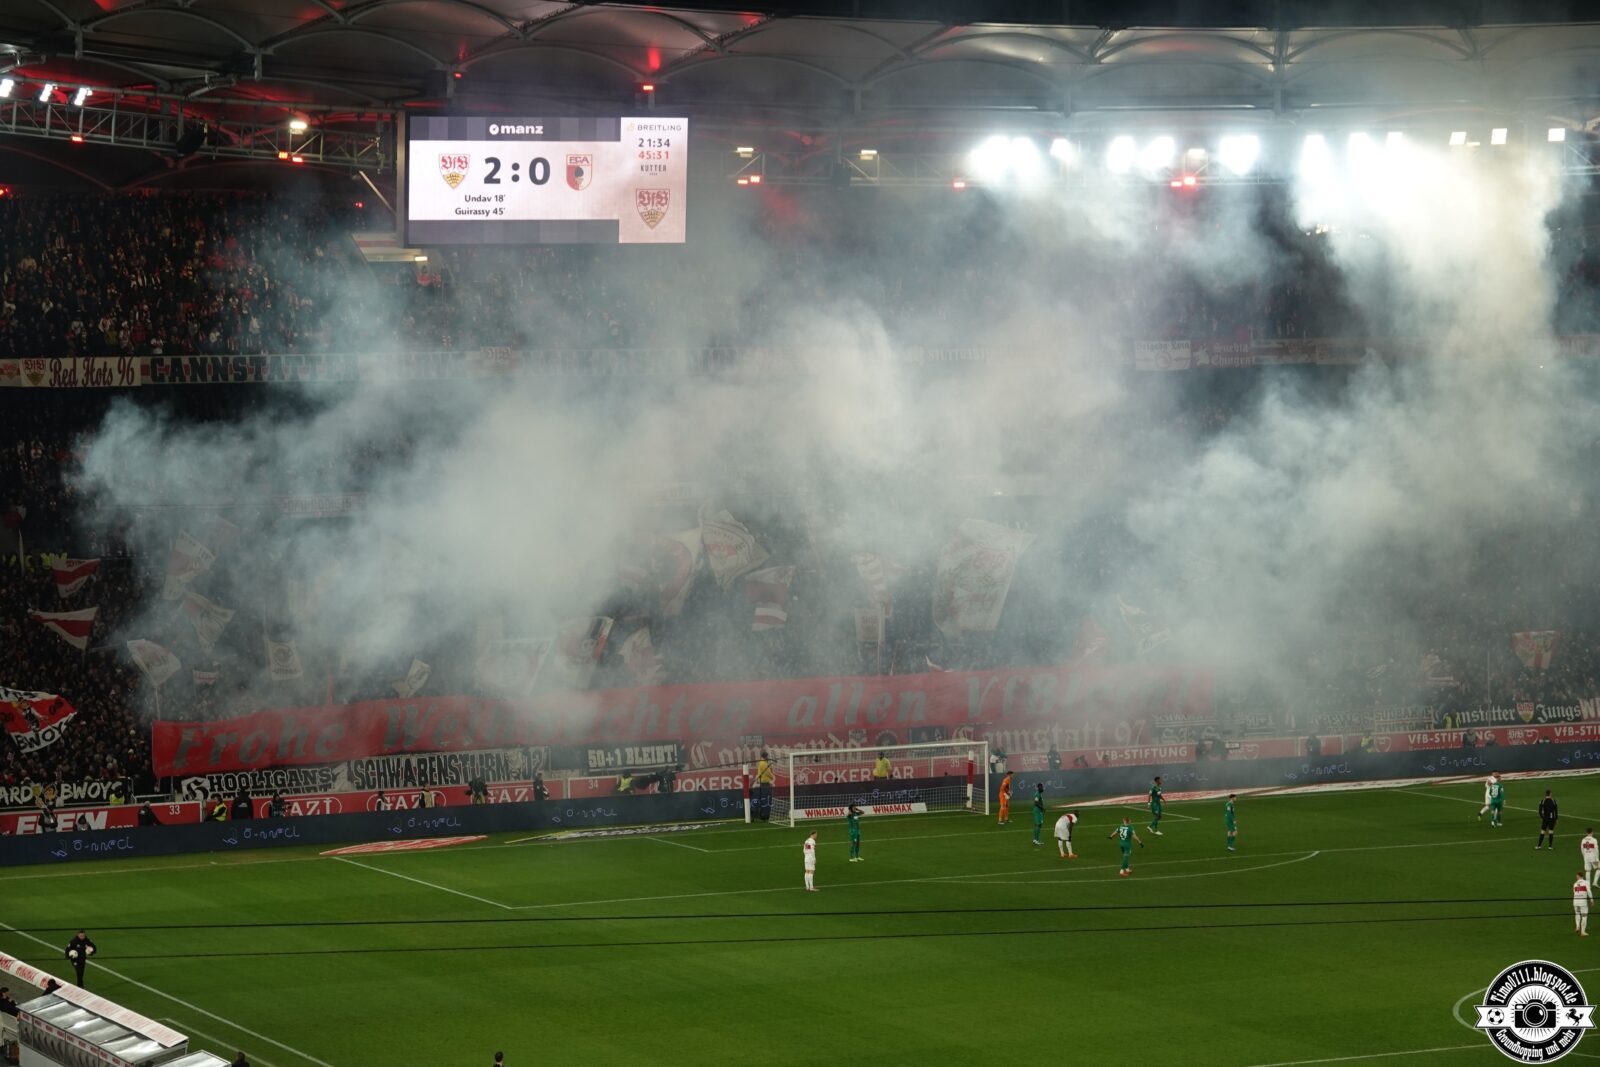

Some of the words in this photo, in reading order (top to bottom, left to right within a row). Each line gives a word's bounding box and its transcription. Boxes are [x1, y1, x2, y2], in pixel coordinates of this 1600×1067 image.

[500, 124, 543, 135] manz
[638, 138, 670, 148] 21:34
[638, 150, 670, 160] 45:31
[484, 156, 550, 185] 2:0
[640, 164, 667, 172] KUTTER
[464, 194, 492, 203] Undav
[455, 207, 490, 217] Guirassy
[50, 357, 78, 387] Red
[82, 357, 114, 387] Hots
[118, 356, 135, 386] 96
[1432, 704, 1516, 724] Cnstatter
[1536, 704, 1581, 723] Jungs
[172, 714, 346, 769] Frohe
[383, 689, 754, 749] Weihchten
[786, 680, 928, 728] allen
[1114, 719, 1147, 746] 97
[1408, 730, 1493, 746] VfB-STIFTNG
[588, 749, 623, 768] 50+1
[625, 743, 678, 765] BLEIBT!
[1096, 746, 1188, 762] VfB-STIFTUNG
[353, 751, 511, 790] SCHWABENSTURM
[950, 759, 961, 768] 35
[207, 768, 333, 794] HOOLIGANS
[815, 766, 914, 785] JOKERAR
[588, 779, 599, 789] 34
[673, 774, 776, 793] JOKERS
[169, 805, 181, 815] 33
[805, 807, 845, 818] WINAMAX
[873, 803, 913, 814] WINAMAX
[1119, 826, 1128, 840] 24
